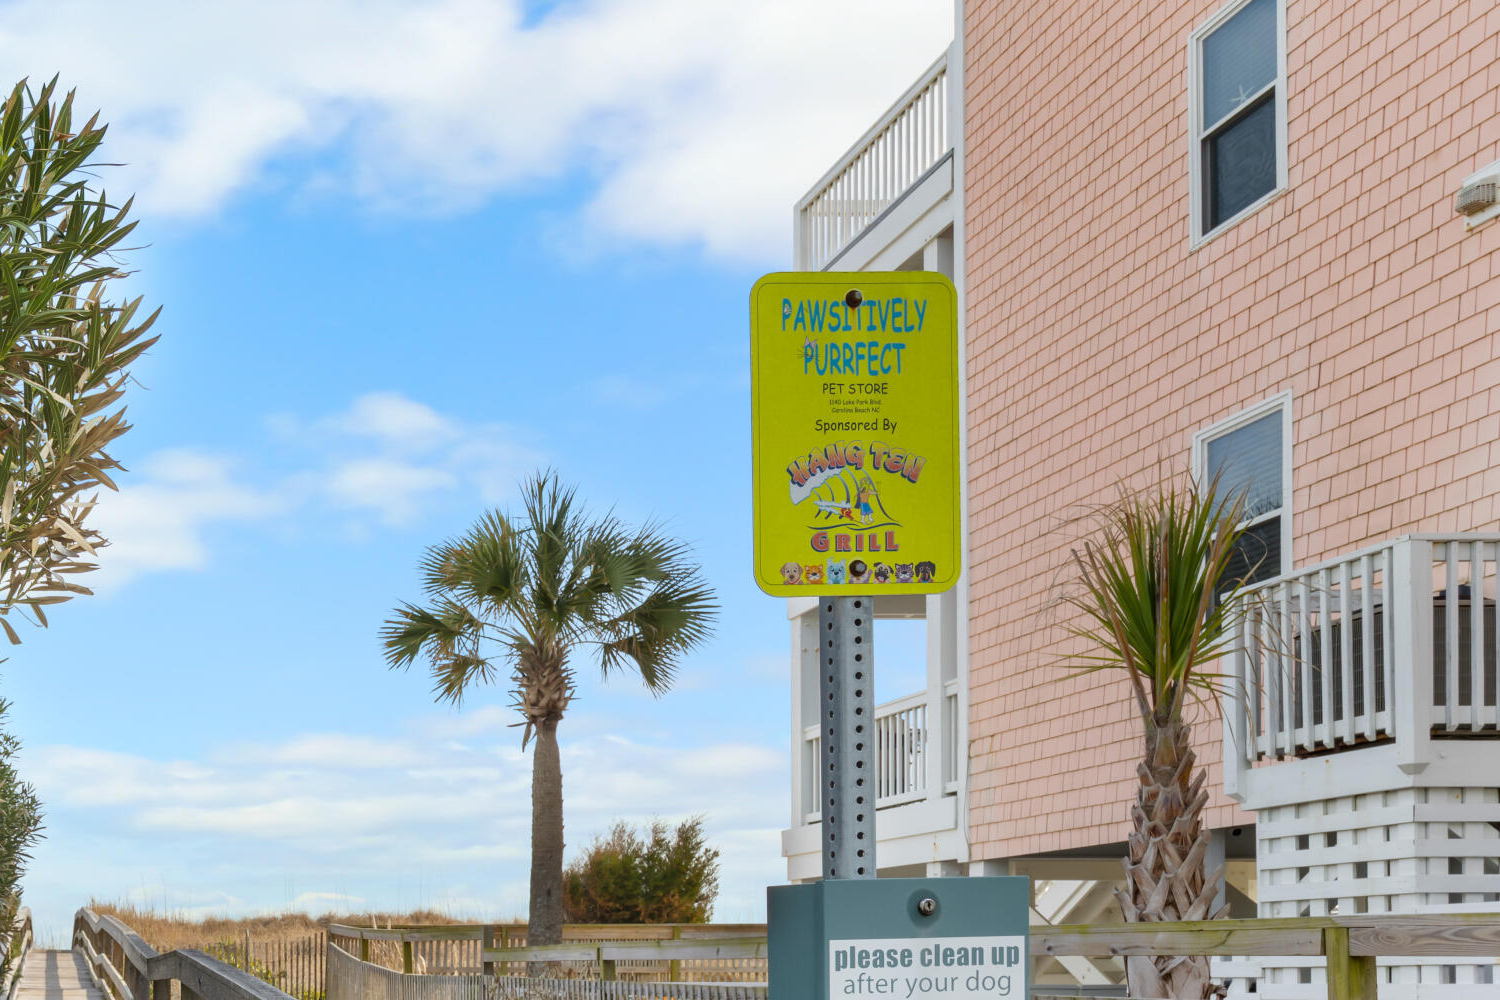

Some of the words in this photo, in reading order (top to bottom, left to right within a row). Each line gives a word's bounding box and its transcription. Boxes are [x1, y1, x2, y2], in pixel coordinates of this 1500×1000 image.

[782, 298, 927, 332] PAWSITIVELY
[803, 341, 906, 376] PURRFECT
[823, 383, 844, 394] PET
[849, 383, 888, 394] STORE
[815, 419, 878, 434] Sponsored
[883, 419, 897, 433] By
[787, 440, 865, 487] HANG
[870, 441, 927, 483] TEN
[811, 530, 899, 552] GRILL
[835, 946, 912, 971] please
[920, 944, 984, 967] clean
[992, 945, 1019, 967] up
[844, 973, 898, 994] after
[906, 976, 958, 998] your
[966, 970, 1011, 996] dog
